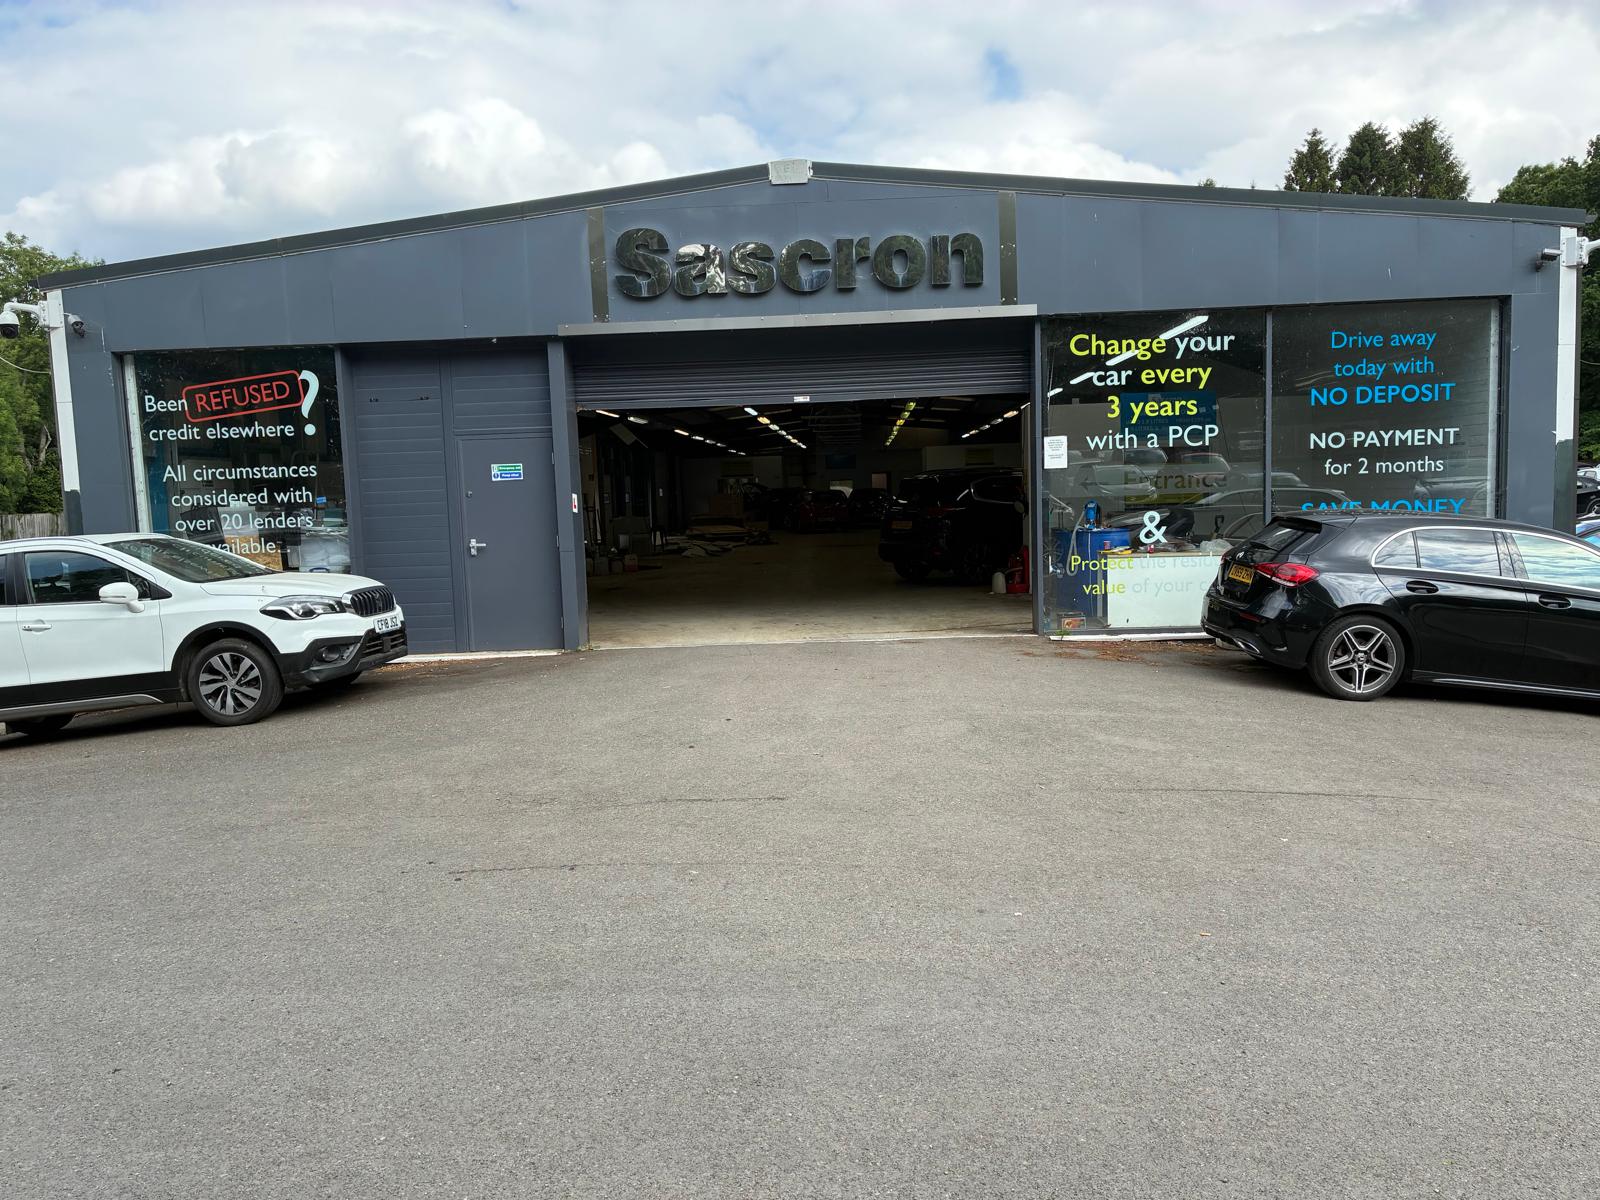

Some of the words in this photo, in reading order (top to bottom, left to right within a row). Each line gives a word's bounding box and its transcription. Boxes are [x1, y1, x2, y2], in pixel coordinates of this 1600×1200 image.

[614, 227, 984, 298] Sascron
[1069, 333, 1167, 361] Change
[1174, 335, 1236, 359] your
[1330, 331, 1384, 349] Drive
[1390, 332, 1437, 350] away
[1092, 369, 1133, 387] car
[1140, 367, 1213, 389] every
[1333, 358, 1387, 381] today
[1392, 355, 1435, 375] with
[144, 395, 188, 412] Been
[194, 380, 290, 413] REFUSED
[1310, 387, 1348, 406] NO
[1356, 382, 1457, 405] DEPOSIT
[1106, 395, 1121, 419] 3
[1129, 398, 1198, 424] years
[149, 423, 201, 442] credit
[206, 421, 295, 440] elsewhere
[1086, 427, 1138, 450] with
[1146, 432, 1160, 448] a
[1168, 424, 1219, 448] PCP
[1309, 431, 1346, 450] NO
[1353, 427, 1460, 448] PAYMENT
[163, 464, 188, 482] All
[193, 463, 318, 482] circumstances
[1324, 459, 1352, 475] for
[1357, 457, 1369, 474] 2
[1375, 455, 1444, 473] months
[171, 488, 268, 507] considered
[274, 486, 313, 504] with
[175, 517, 215, 532] over
[221, 513, 243, 530] 20
[249, 511, 314, 529] lenders
[1138, 510, 1169, 544] &
[1070, 555, 1134, 571] Protect
[1140, 555, 1167, 569] the
[1082, 579, 1127, 596] value
[1131, 577, 1150, 593] of
[1154, 580, 1193, 598] your
